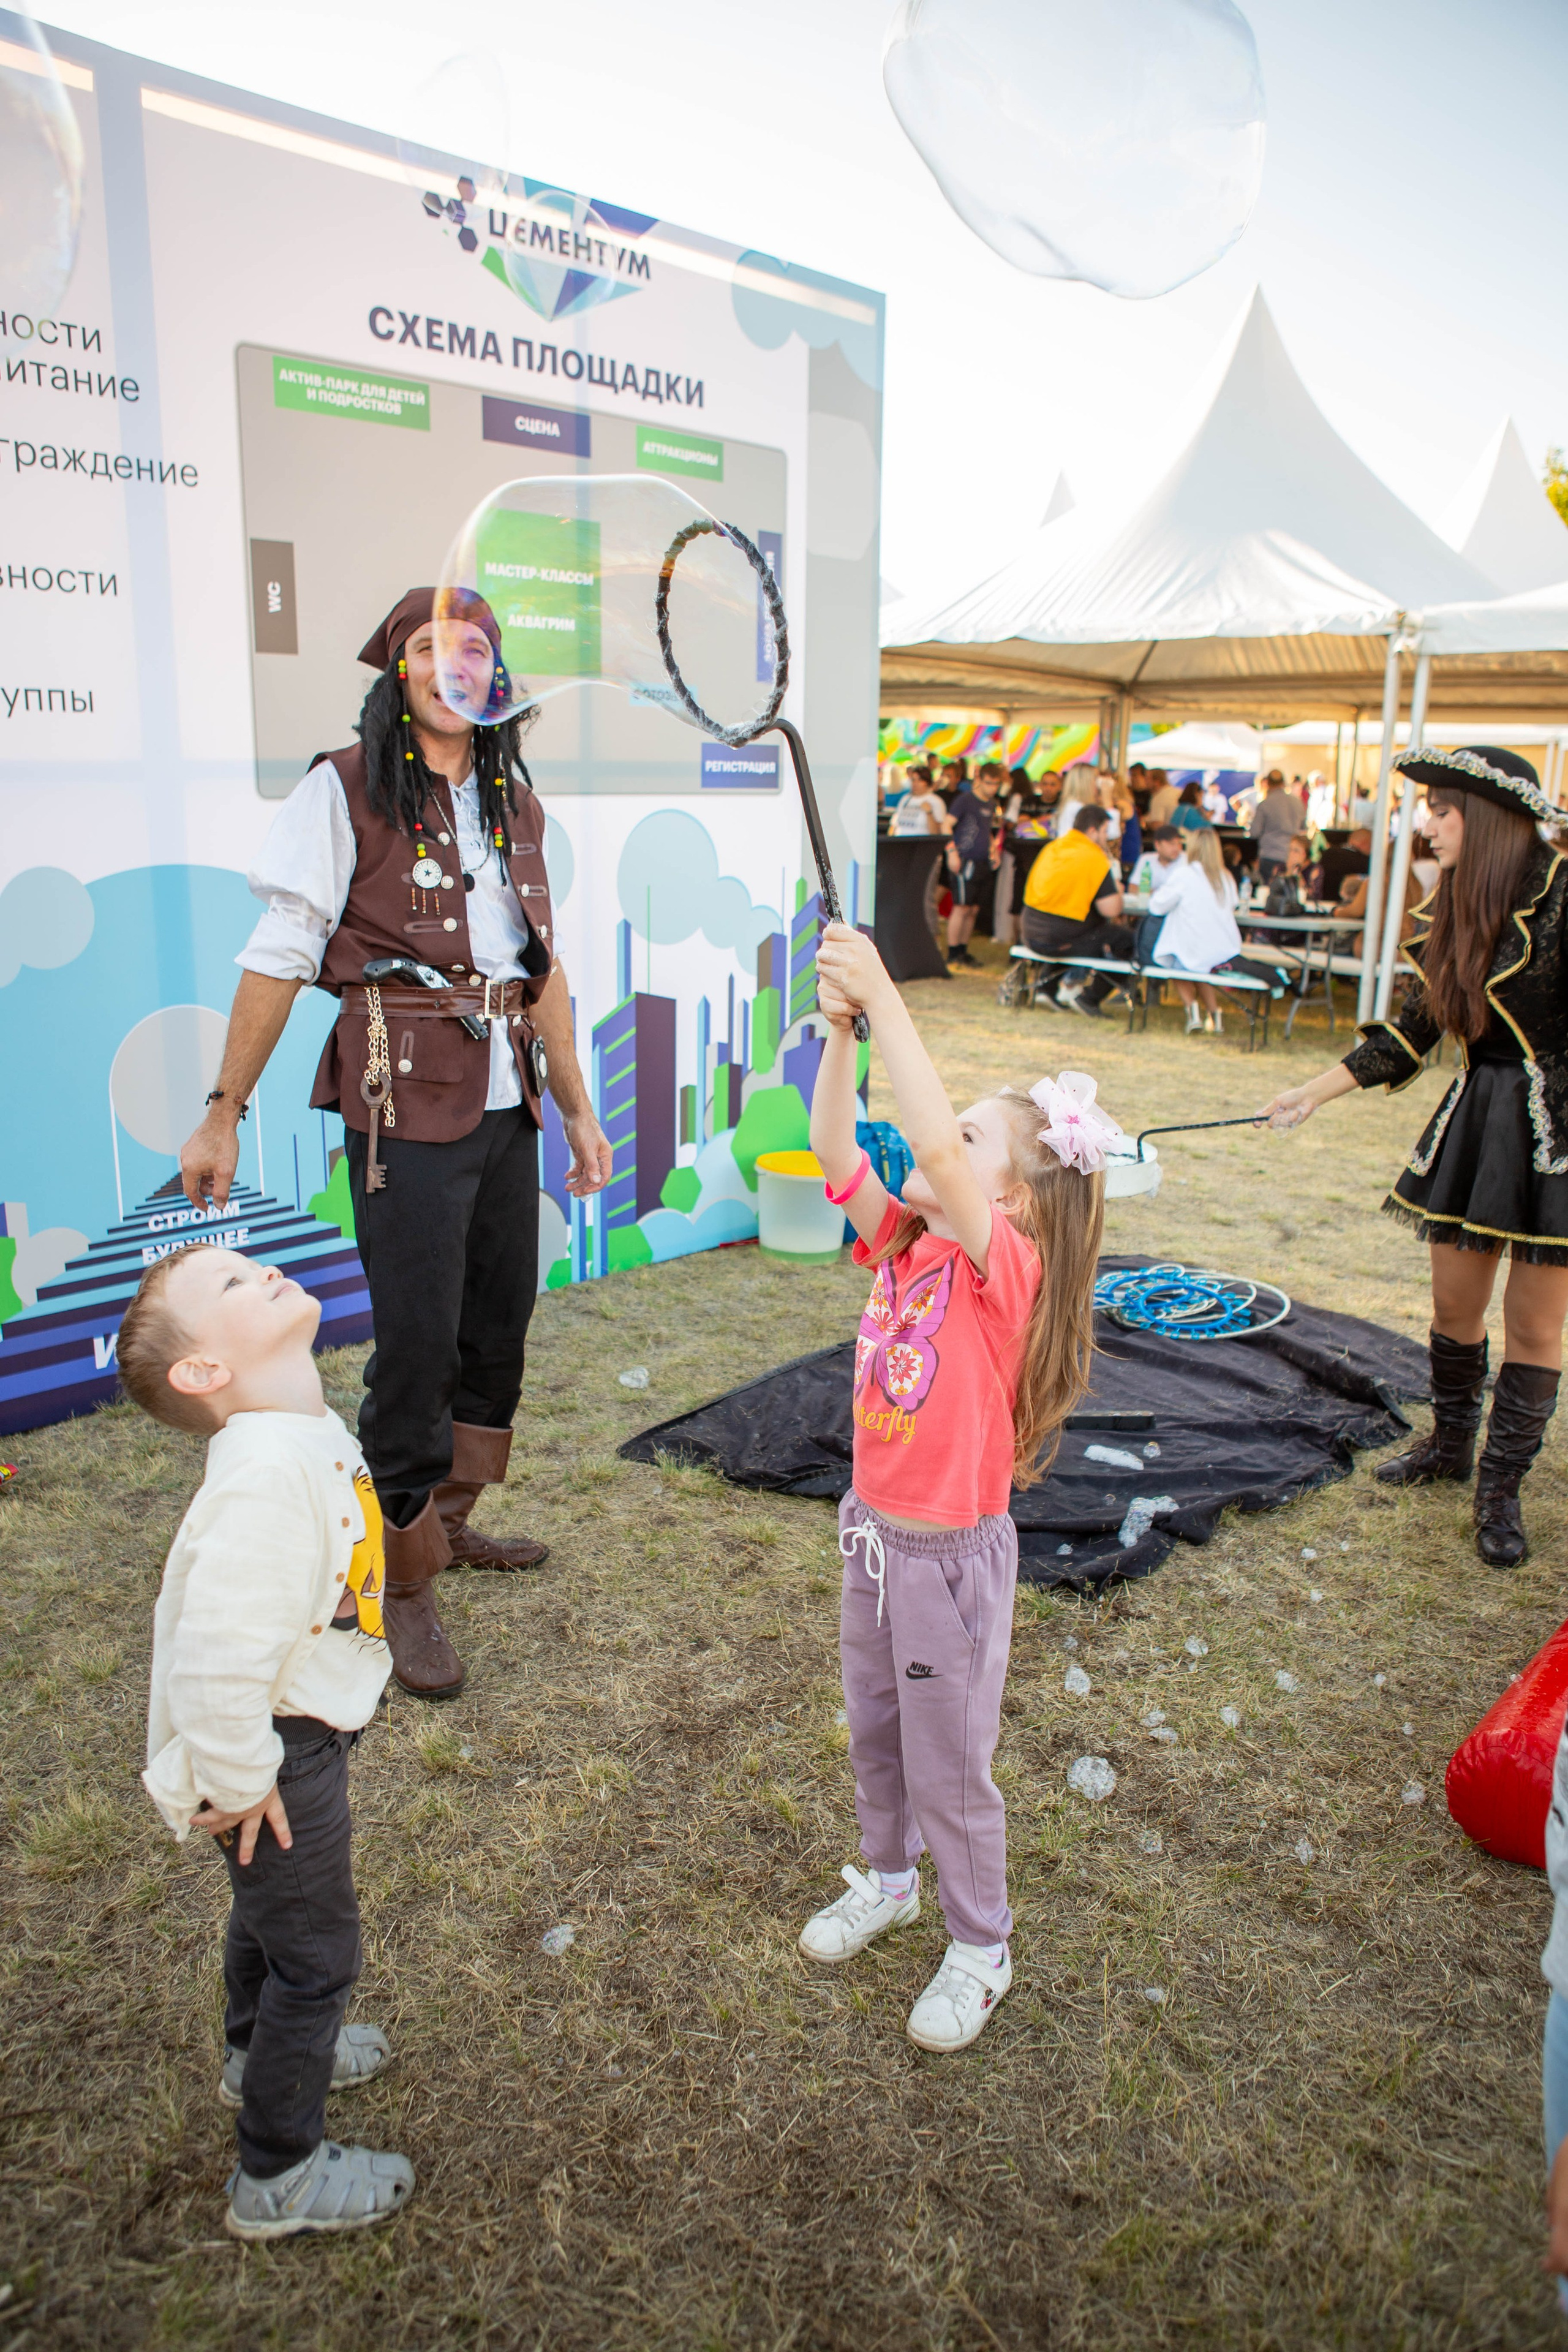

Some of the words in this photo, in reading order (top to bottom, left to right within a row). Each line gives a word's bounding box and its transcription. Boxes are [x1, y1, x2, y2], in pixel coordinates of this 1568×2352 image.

[369, 306, 503, 364] СХЕМА
[513, 337, 704, 408] ПЛОЩАДКИ
[0, 357, 140, 402] итание
[279, 368, 359, 394] АКТИВ-ПАРК
[361, 383, 386, 399] ДЛЯ
[387, 387, 425, 405] ДЕТЕЙ
[307, 388, 317, 401] И
[318, 390, 402, 415] ПОДРОСТКОВ
[514, 415, 560, 437] СЦЕНА
[643, 441, 718, 466] АТТРАКЦИОНЫ
[0, 565, 118, 596] ности
[485, 562, 594, 586] МАСТЕР-КЛАССЫ
[267, 581, 282, 613] WC
[507, 614, 576, 631] АКВАГРИМ
[706, 761, 775, 775] РЕГИСТРАЦИЯ
[148, 1200, 240, 1232] СТРОИМ
[910, 1661, 934, 1676] NIKE
